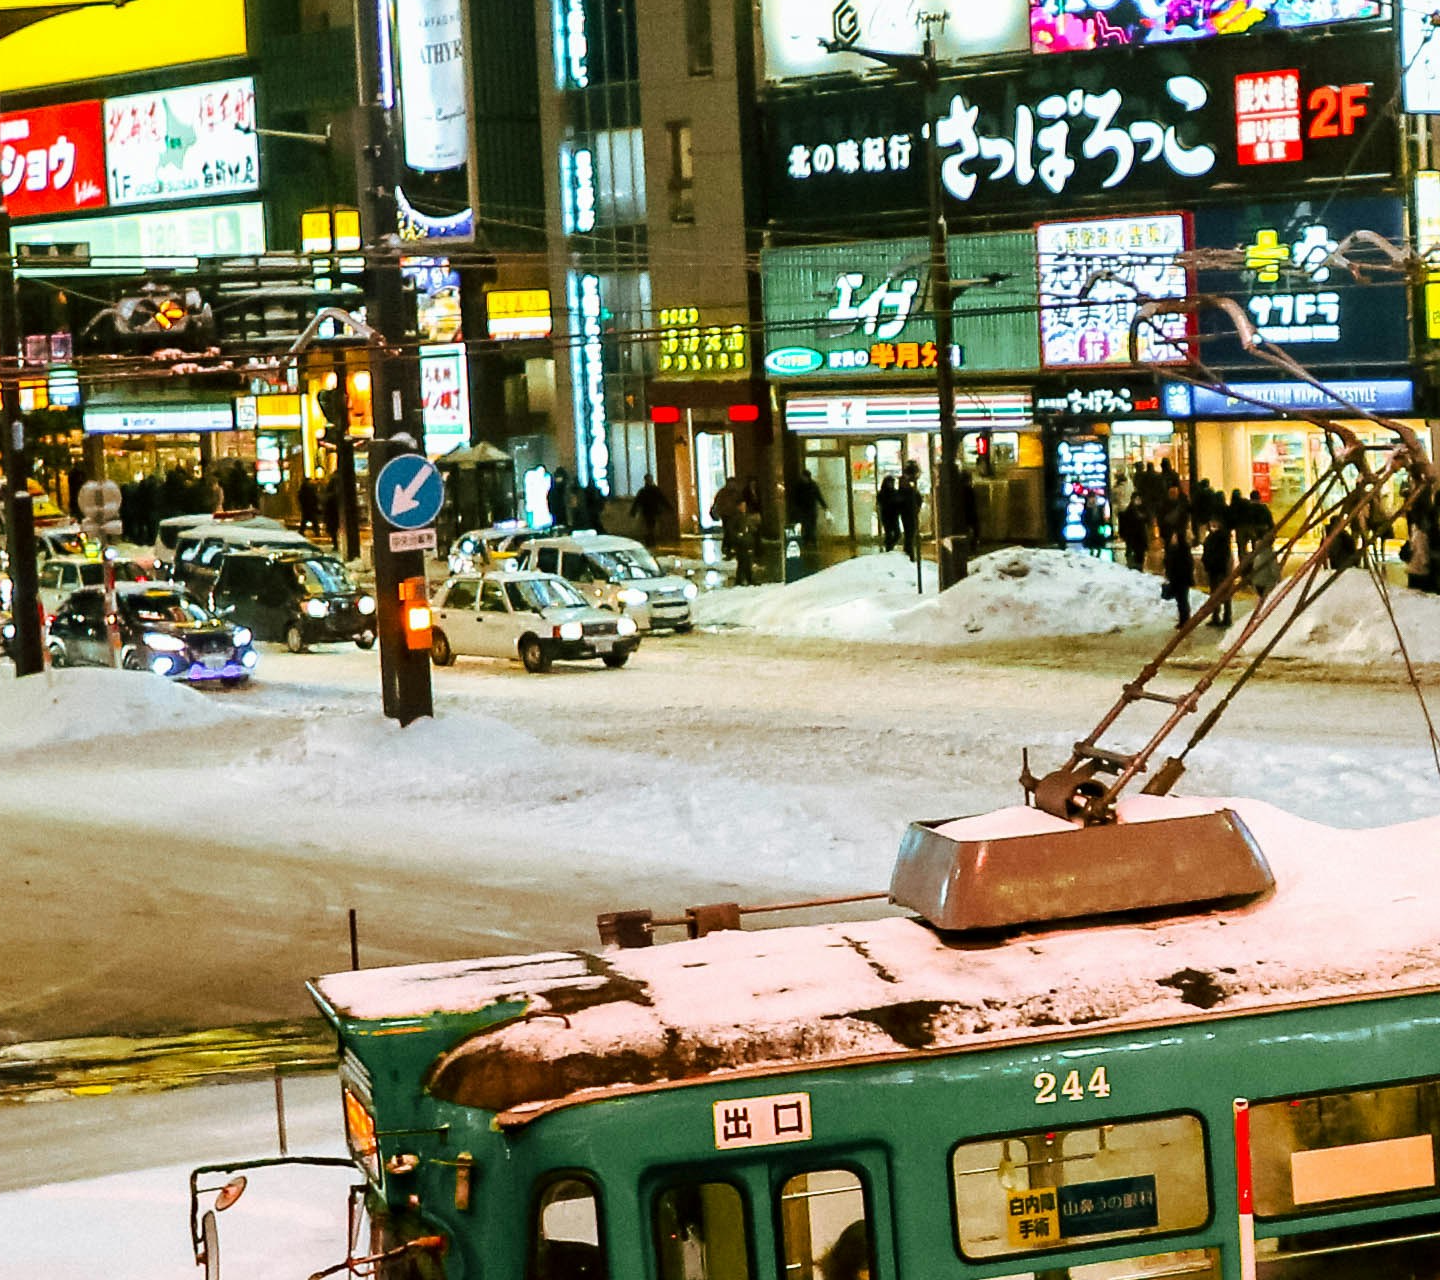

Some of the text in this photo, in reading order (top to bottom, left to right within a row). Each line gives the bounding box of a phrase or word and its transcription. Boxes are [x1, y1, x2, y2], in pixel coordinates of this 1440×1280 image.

[1308, 84, 1370, 140] 2F
[788, 133, 912, 179] 北の味紀行
[937, 76, 1217, 201] さっぽろっこ
[1033, 1066, 1111, 1105] 244
[723, 1100, 807, 1143] 出口
[1009, 1192, 1057, 1216] 白内障
[1018, 1217, 1050, 1240] 手術
